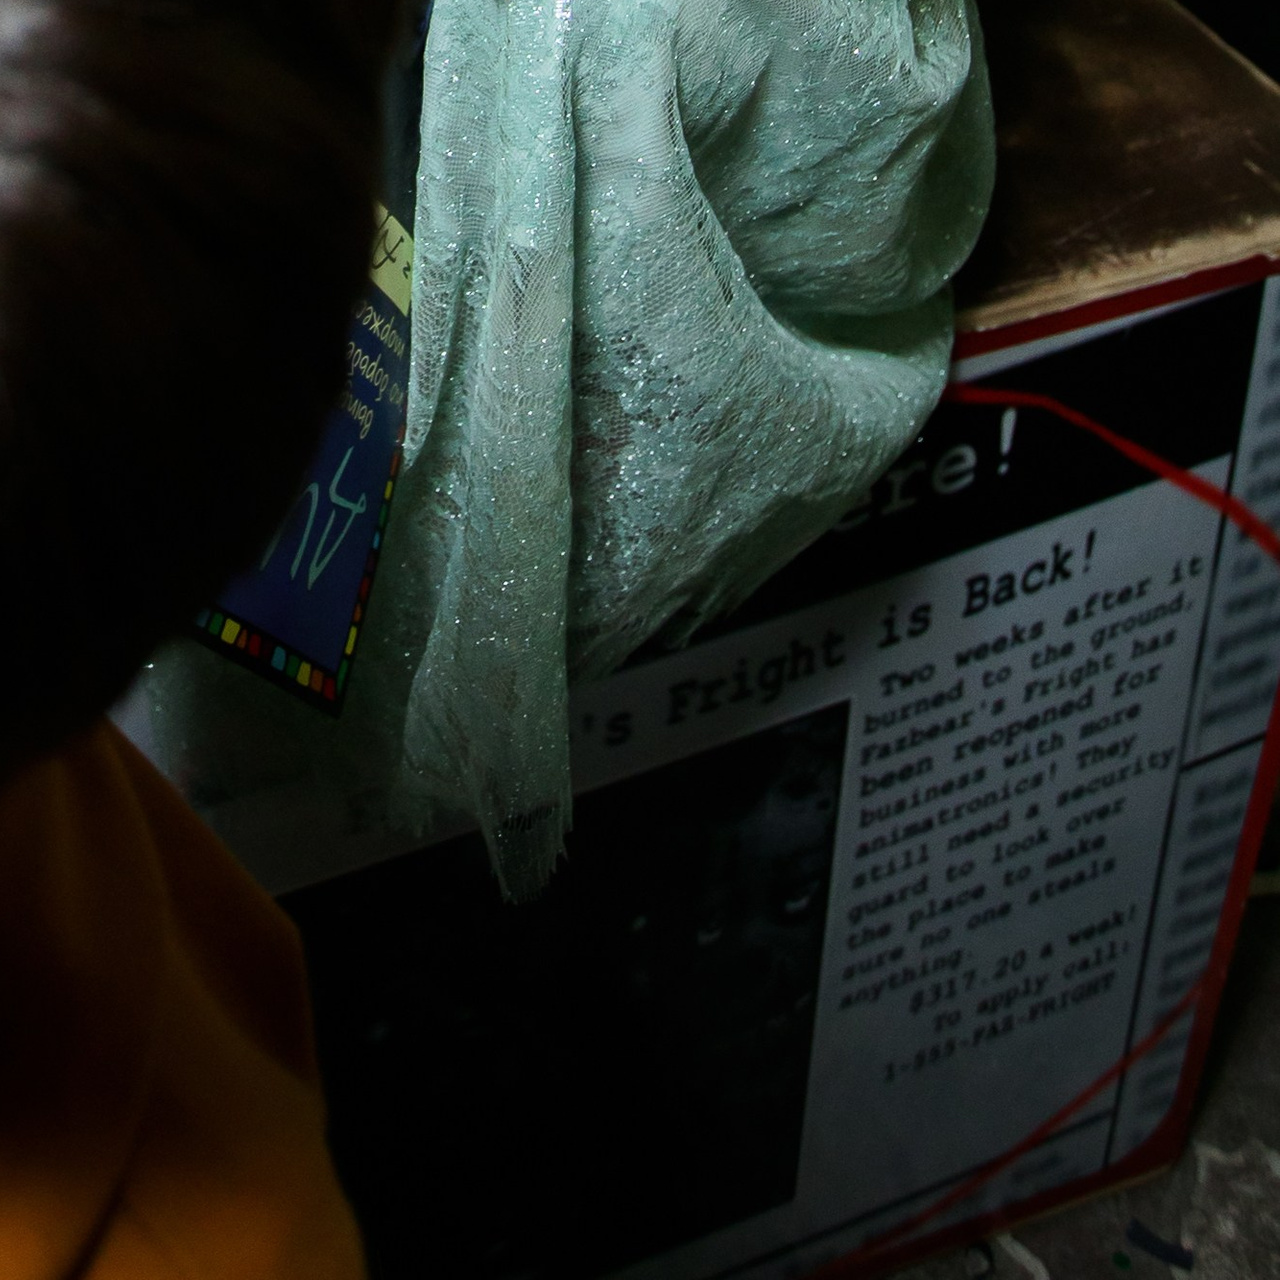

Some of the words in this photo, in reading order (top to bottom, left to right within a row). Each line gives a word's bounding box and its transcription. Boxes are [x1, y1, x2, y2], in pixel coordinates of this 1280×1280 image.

[668, 630, 845, 725] Fright
[878, 604, 932, 649] is
[962, 529, 1097, 619] Back!
[864, 679, 965, 735] burned
[982, 665, 1012, 689] to
[1030, 641, 1074, 670] the
[880, 664, 935, 698] Two
[955, 620, 1044, 667] weeks
[1063, 577, 1152, 626] after
[1170, 555, 1203, 585] it
[860, 698, 1005, 766] Fazbear's
[1024, 655, 1116, 703] Fright
[1130, 630, 1177, 659] has
[860, 756, 934, 798] been
[952, 688, 1094, 762] reopened
[1111, 663, 1162, 698] for
[1076, 734, 1138, 770] They
[852, 843, 930, 889] still
[947, 810, 1011, 851] need
[1025, 803, 1039, 819] a
[1055, 747, 1176, 808] security
[859, 767, 986, 828] business
[1003, 732, 1065, 770] with
[1079, 702, 1142, 740] more
[842, 946, 904, 981] sure
[920, 927, 951, 950] no
[966, 902, 1012, 931] one
[1027, 857, 1116, 906] steals
[847, 922, 892, 951] the
[908, 885, 985, 931] place
[1002, 864, 1031, 888] to
[1045, 835, 1106, 870] make
[848, 875, 929, 924] guard
[945, 860, 974, 883] to
[992, 827, 1050, 864] look
[1066, 797, 1126, 834] over
[933, 1010, 961, 1033] To
[976, 973, 1049, 1016] apply
[1039, 943, 1054, 960] a
